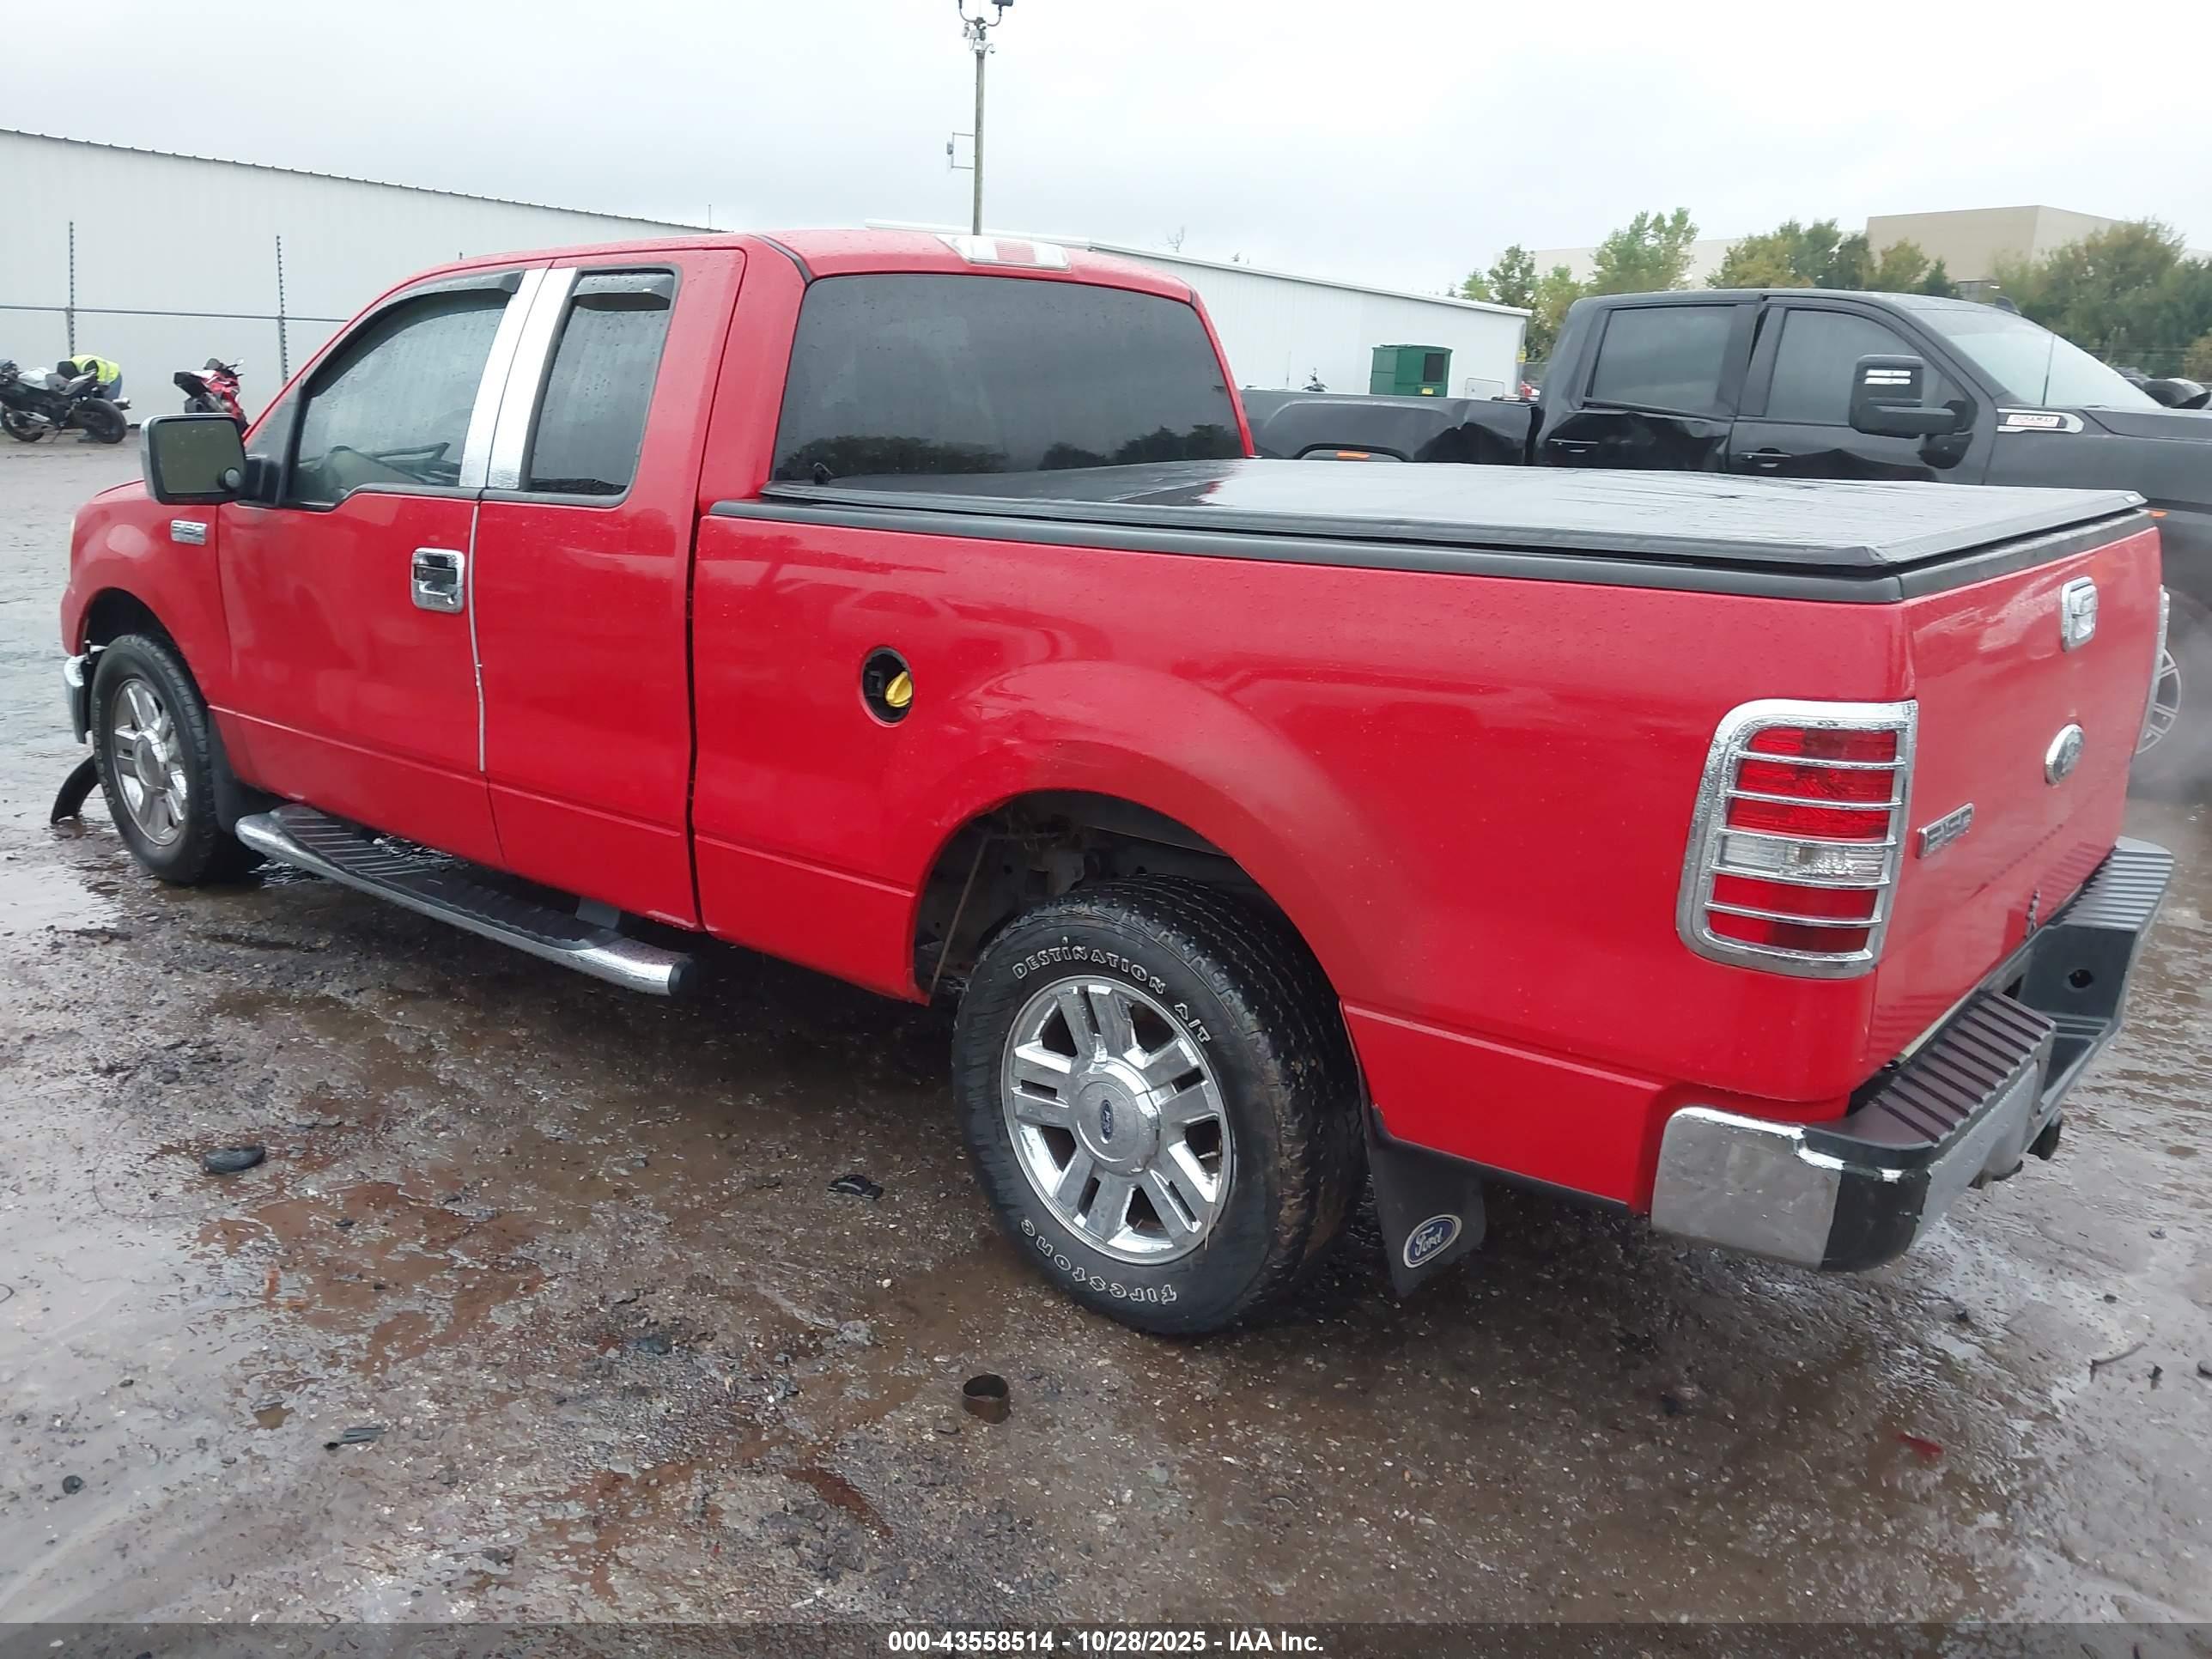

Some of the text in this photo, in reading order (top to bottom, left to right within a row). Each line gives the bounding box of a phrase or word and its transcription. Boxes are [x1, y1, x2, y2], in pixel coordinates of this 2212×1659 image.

[1012, 945, 1212, 1043] DESTINATION A/T
[1414, 1226, 1443, 1257] Ford
